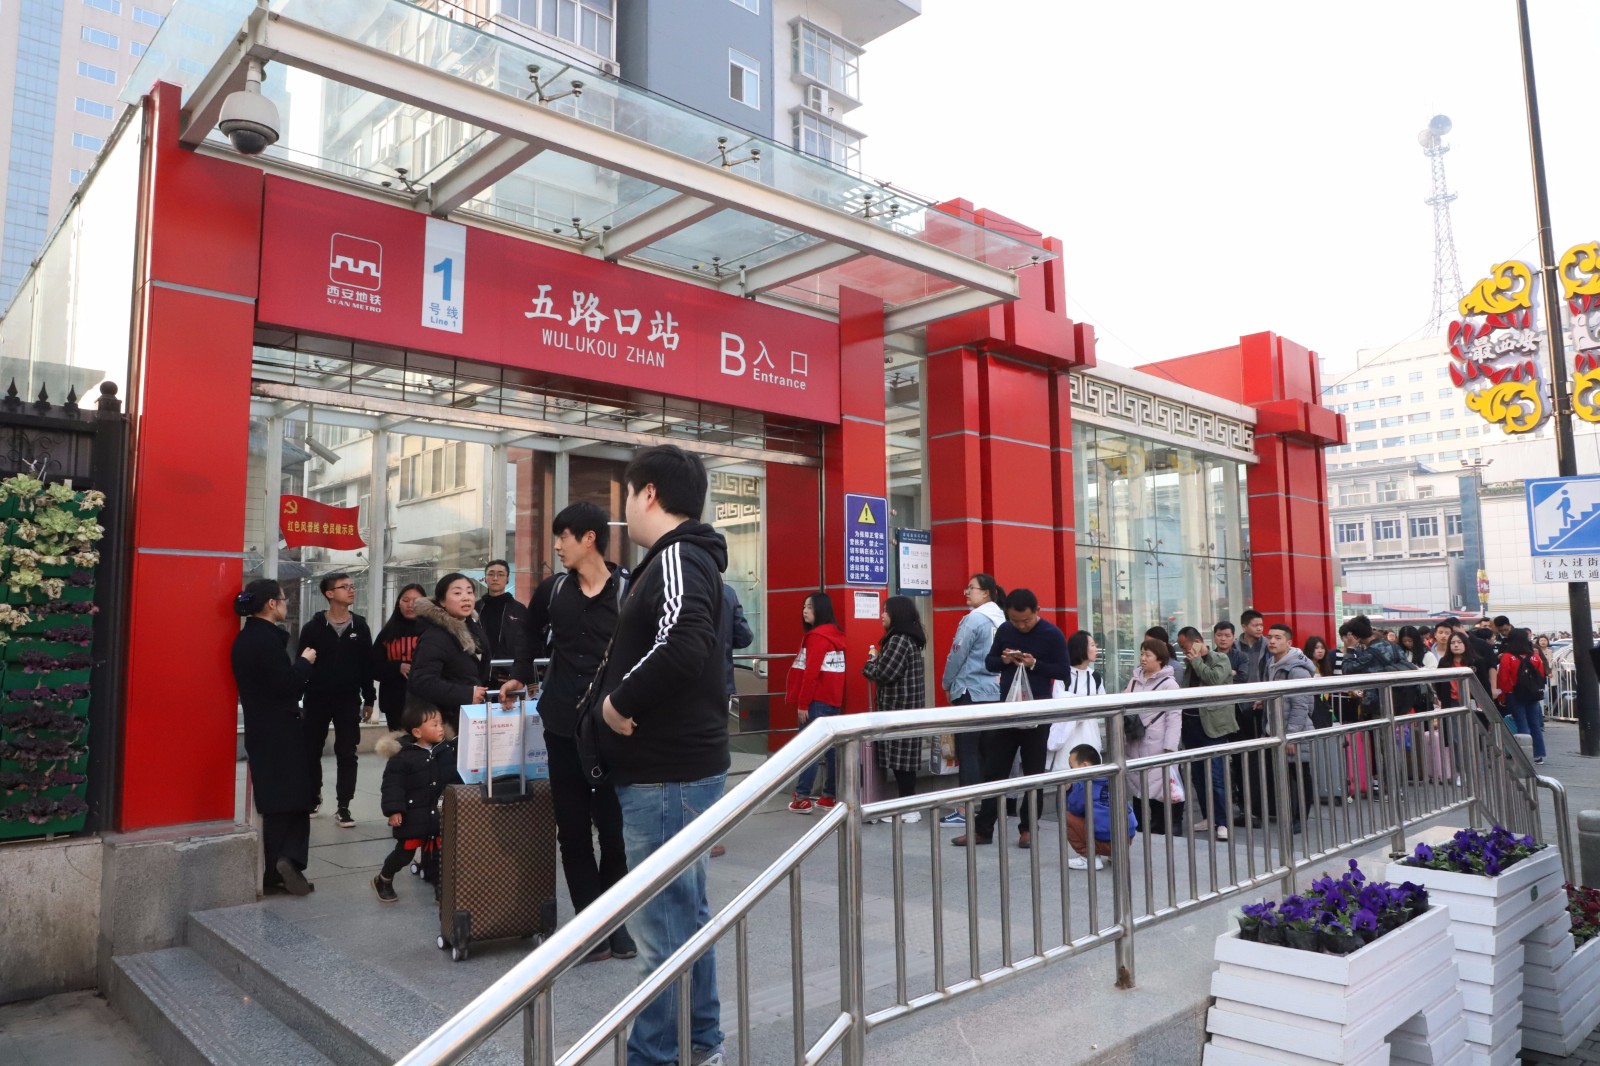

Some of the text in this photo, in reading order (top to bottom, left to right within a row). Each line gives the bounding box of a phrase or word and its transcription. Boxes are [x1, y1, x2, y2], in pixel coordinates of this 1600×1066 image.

[433, 257, 453, 302] 1
[326, 285, 382, 306] 西安地铁
[351, 302, 382, 313] METRO
[428, 302, 459, 320] 号线
[430, 316, 449, 326] Line
[524, 284, 680, 351] 五路口站
[542, 328, 665, 368] WULUKOU ZHAN
[721, 331, 808, 377] B 入口
[753, 367, 807, 390] Entrance
[287, 520, 354, 536] 红色风景线 党员做示范
[1542, 557, 1599, 568] 行人过街
[1544, 569, 1600, 580] 走地铁通
